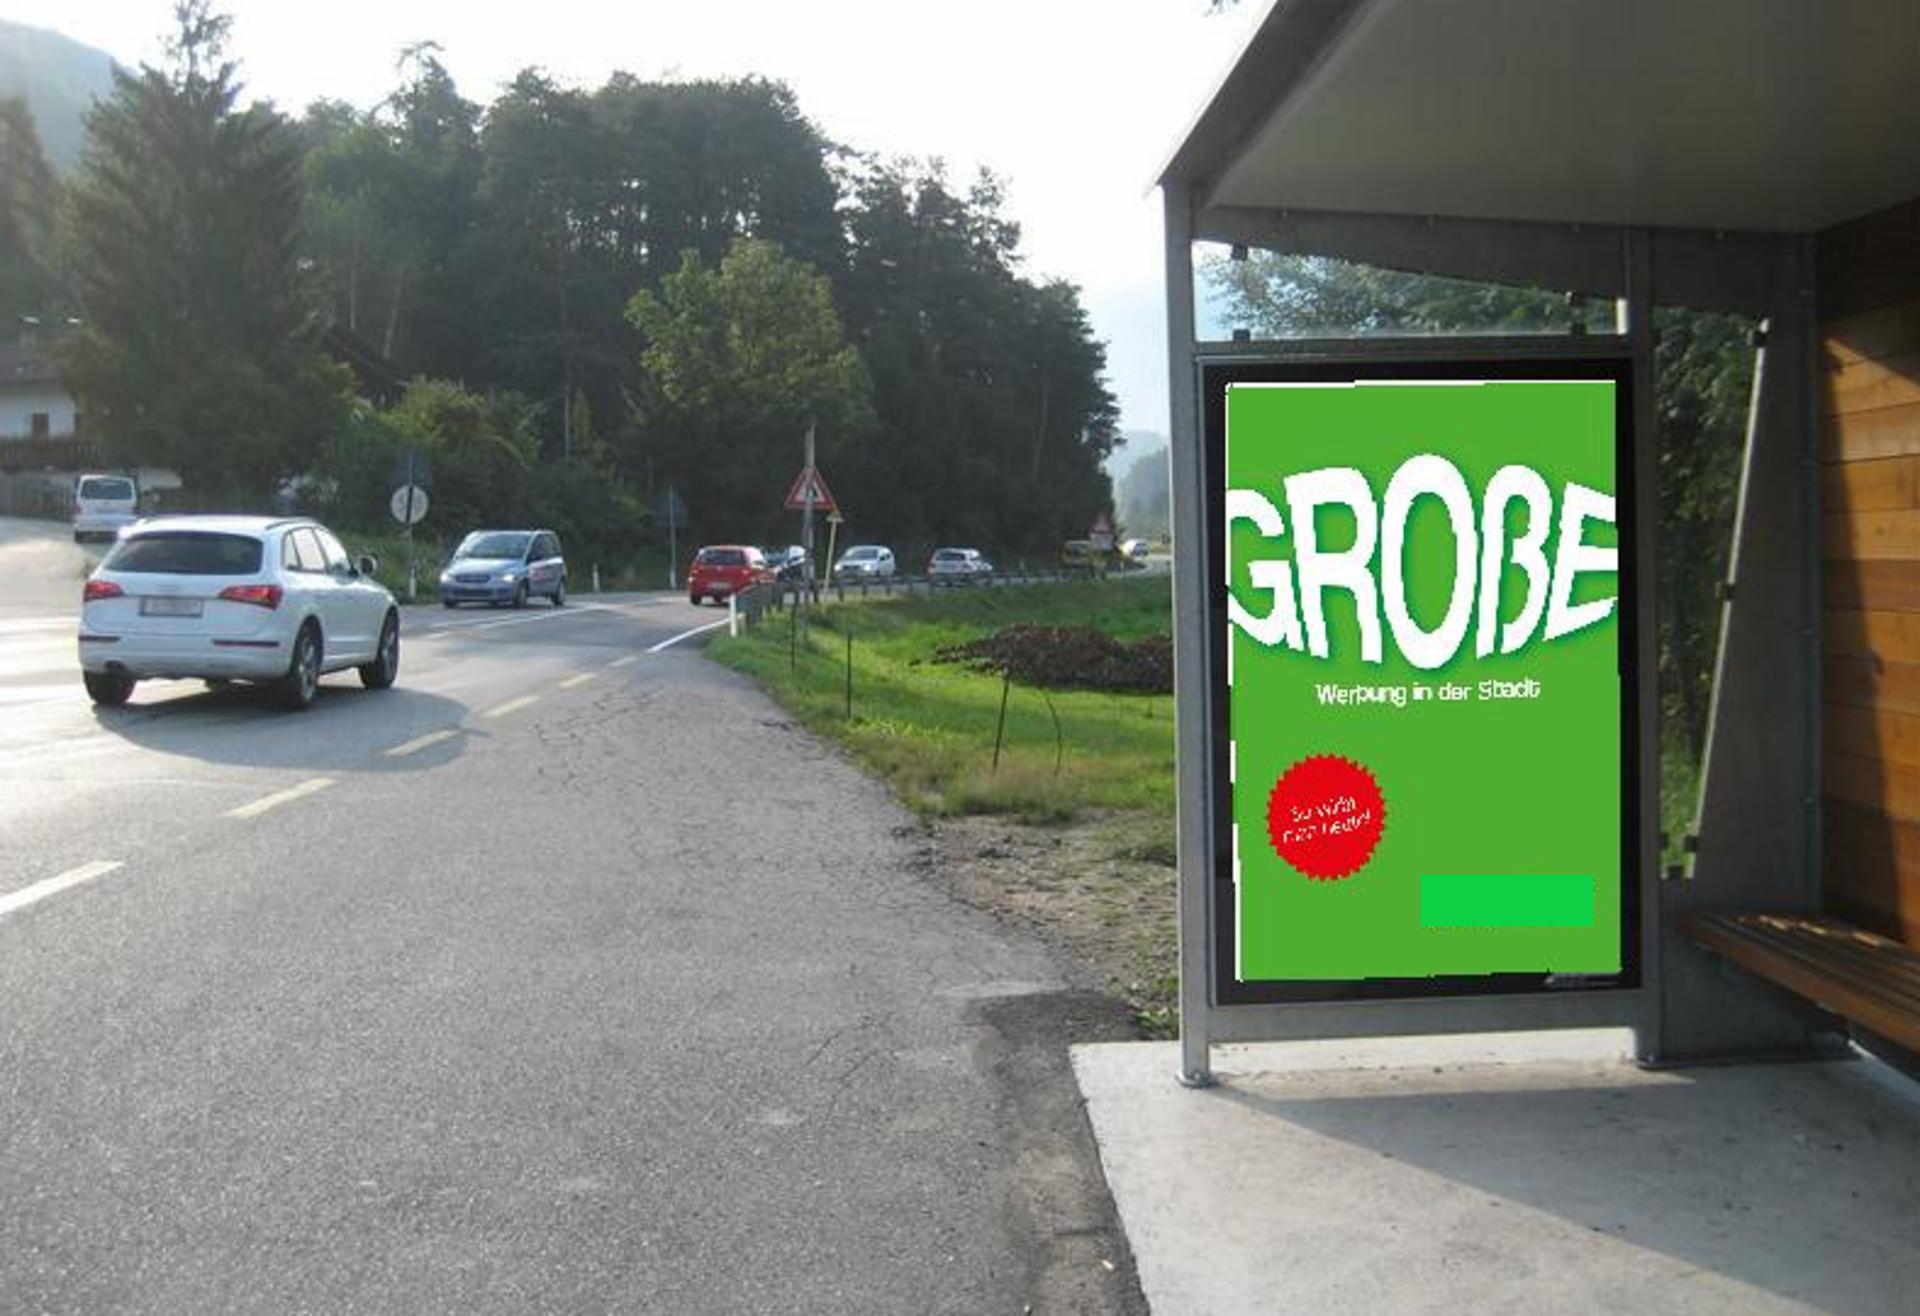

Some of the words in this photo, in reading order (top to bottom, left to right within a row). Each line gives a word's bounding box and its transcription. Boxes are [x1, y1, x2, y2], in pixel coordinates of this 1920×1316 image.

[1315, 683, 1407, 707] Werbung
[1412, 683, 1434, 700] in
[1437, 682, 1473, 700] der
[1478, 677, 1541, 700] Stadt
